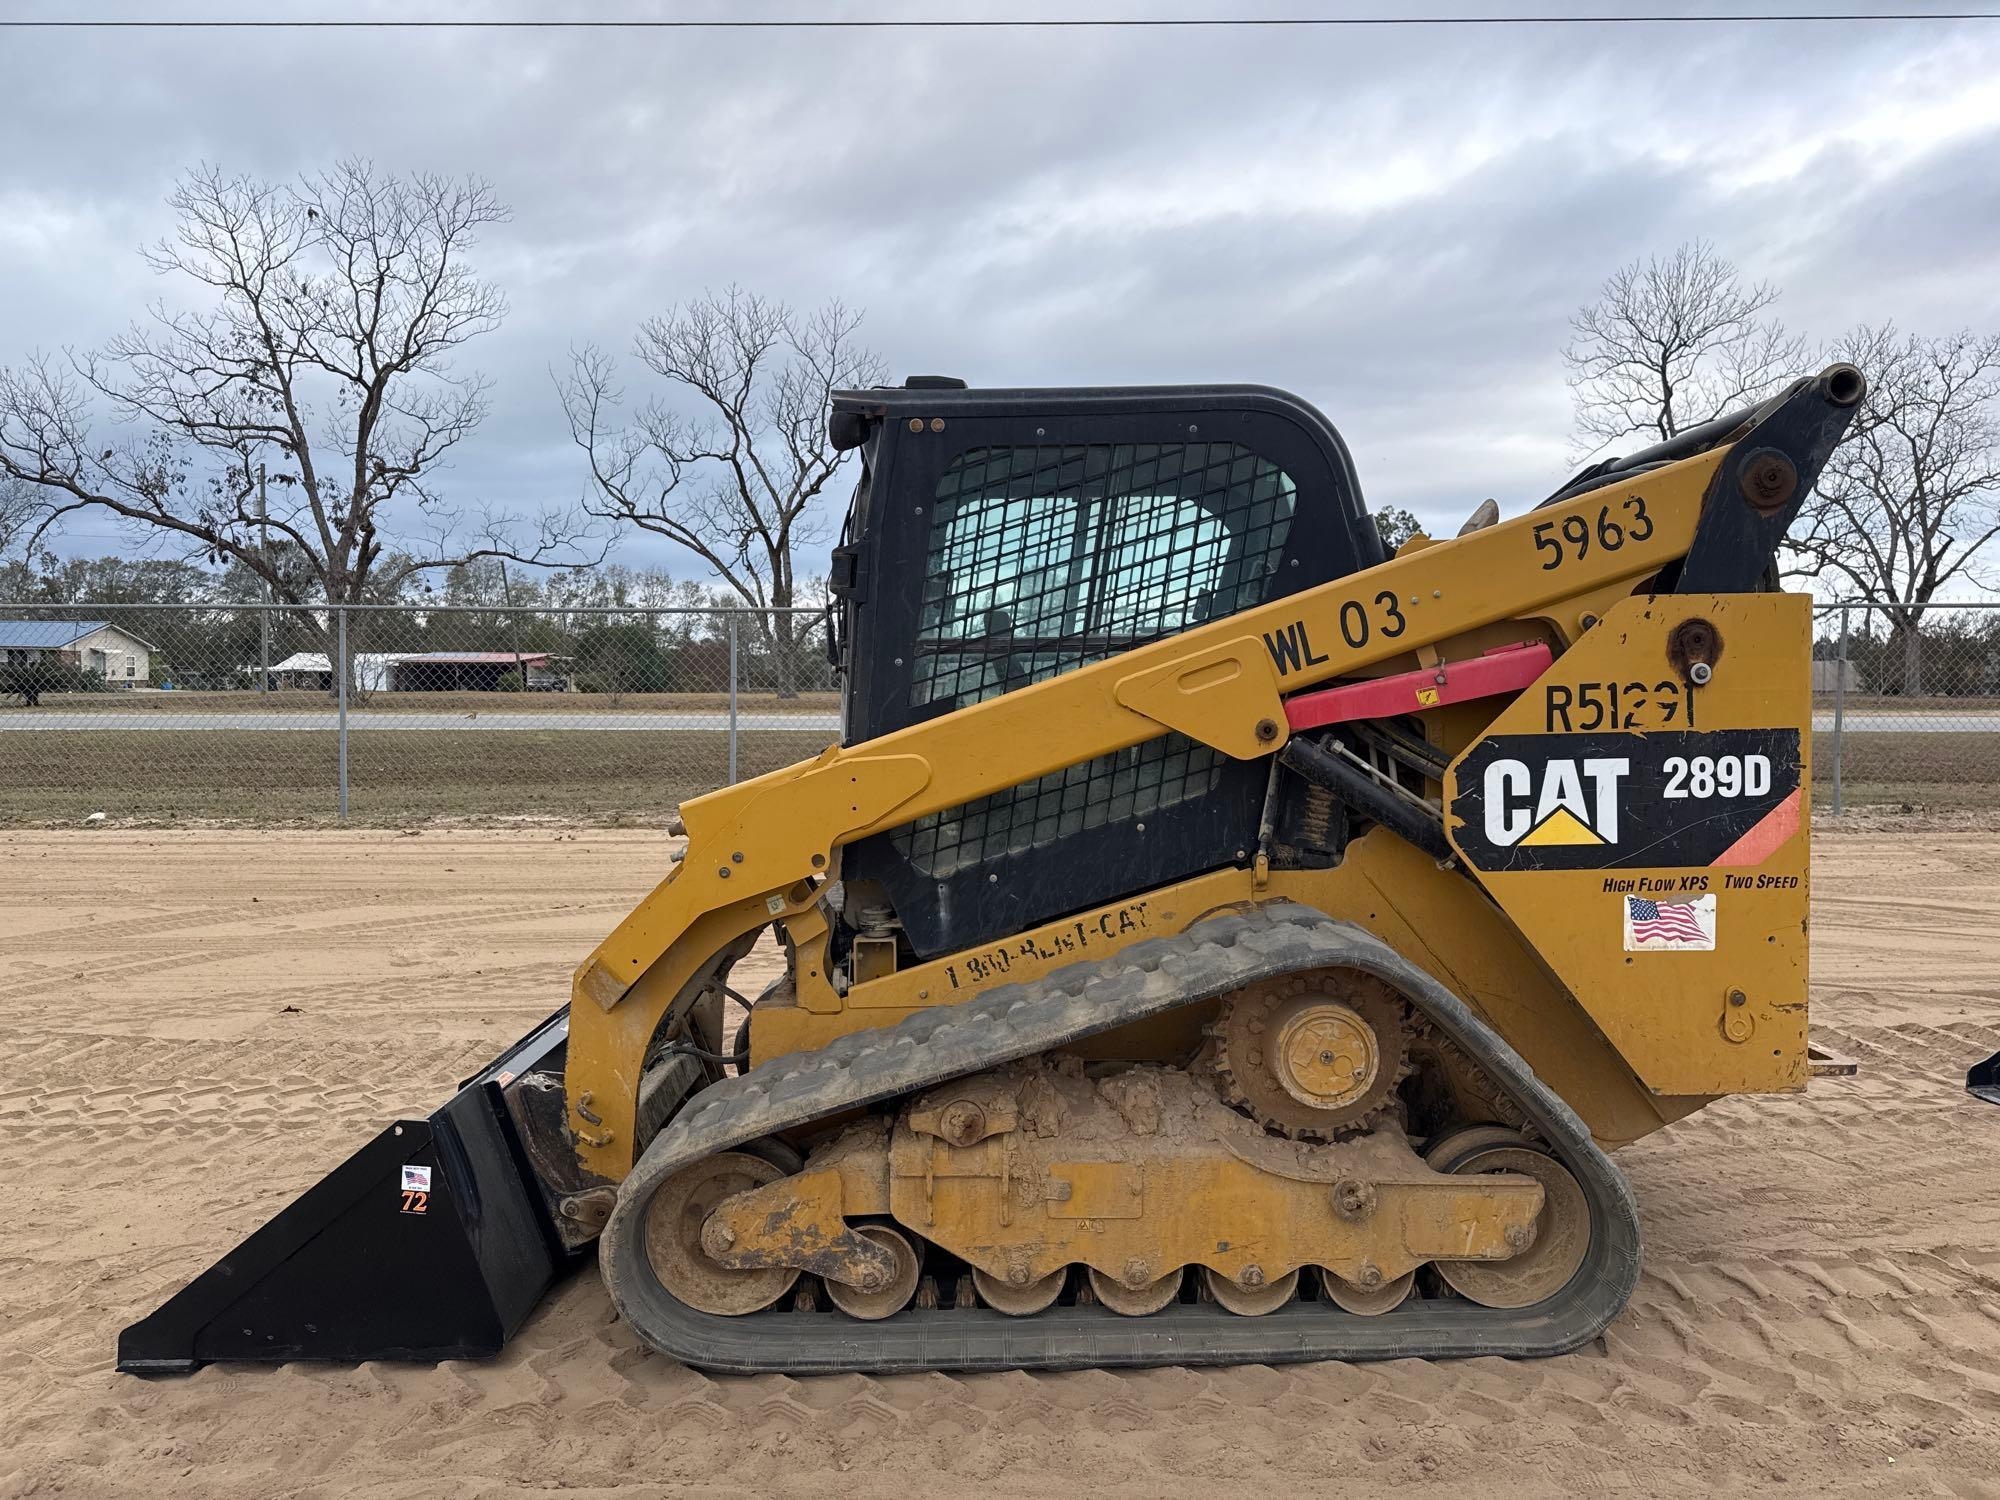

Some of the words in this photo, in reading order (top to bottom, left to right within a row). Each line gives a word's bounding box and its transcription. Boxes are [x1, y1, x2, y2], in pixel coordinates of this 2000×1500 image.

[1533, 496, 1654, 570] 5963
[1263, 620, 1329, 676] WL
[1340, 590, 1406, 648] 03
[1484, 758, 1629, 847] CAT
[1663, 754, 1771, 798] 289D
[1679, 875, 1709, 891] XPS
[401, 1191, 427, 1211] 72
